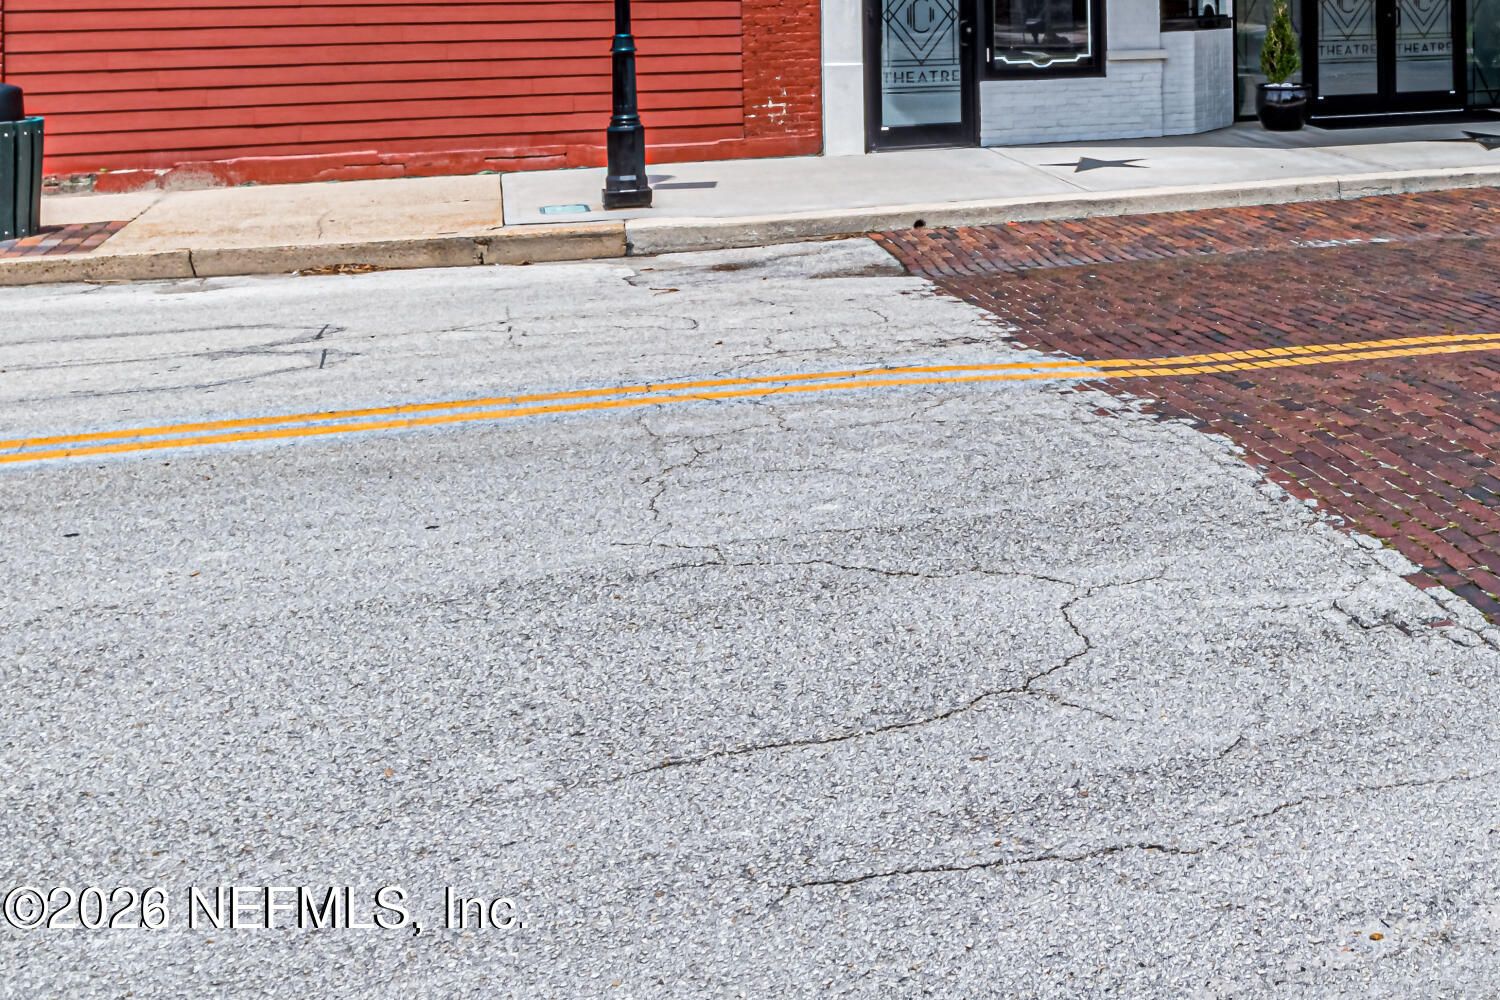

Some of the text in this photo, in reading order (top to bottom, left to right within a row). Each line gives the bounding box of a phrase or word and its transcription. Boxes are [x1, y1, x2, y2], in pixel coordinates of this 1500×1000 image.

[1319, 43, 1377, 56] THEATRE
[1396, 42, 1452, 53] THEATRE
[884, 70, 960, 83] THEATRE
